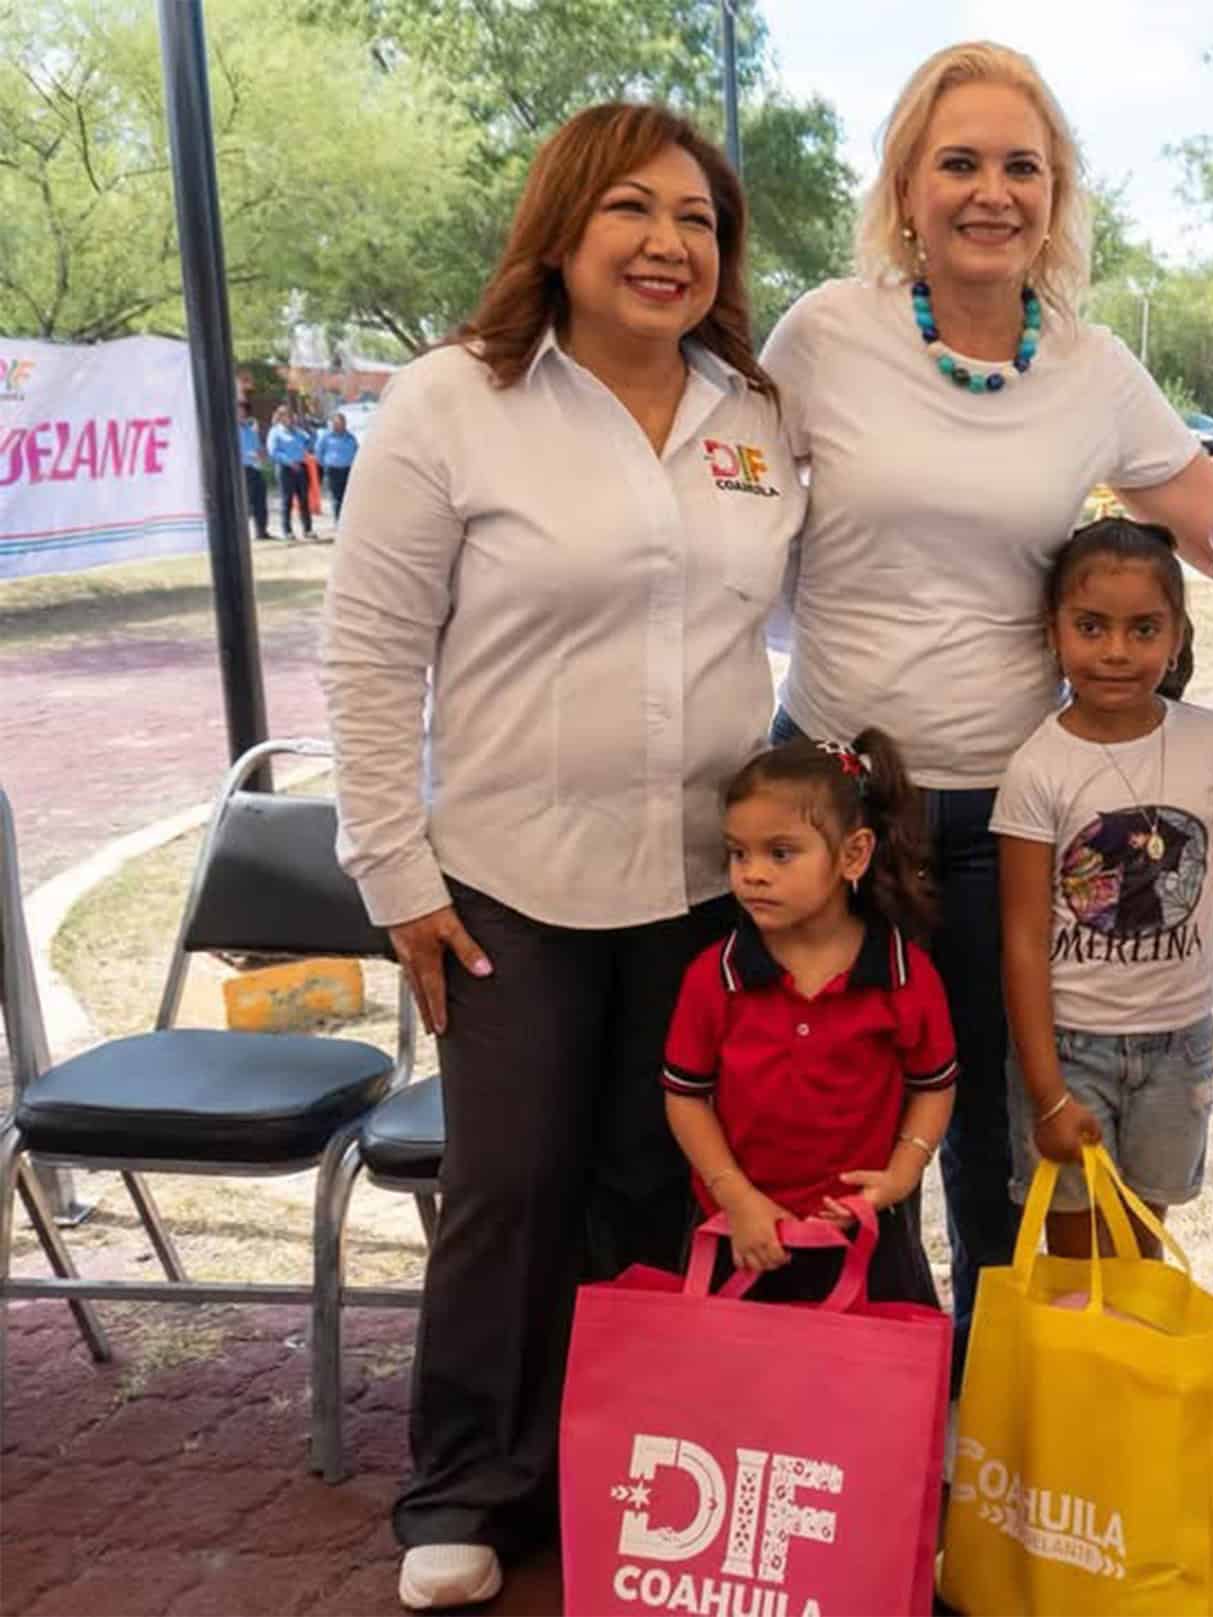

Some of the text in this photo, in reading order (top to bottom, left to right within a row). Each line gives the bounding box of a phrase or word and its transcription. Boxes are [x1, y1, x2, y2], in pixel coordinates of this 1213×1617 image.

[703, 439, 768, 482] DIF
[1050, 922, 1202, 965] MERLINA
[617, 1433, 844, 1584] DIF
